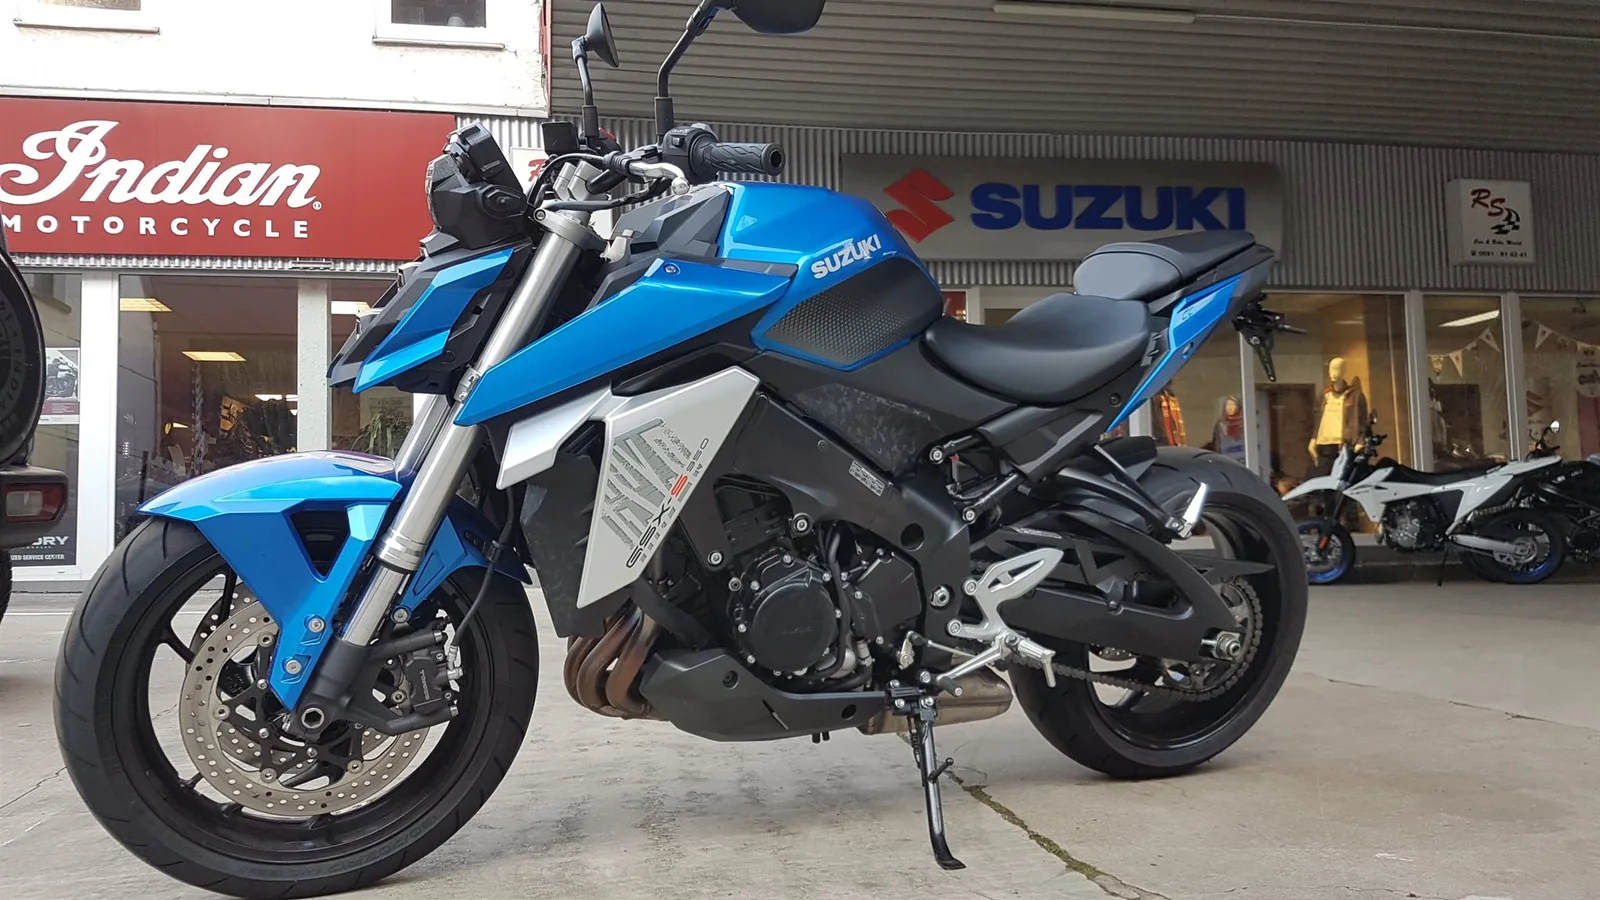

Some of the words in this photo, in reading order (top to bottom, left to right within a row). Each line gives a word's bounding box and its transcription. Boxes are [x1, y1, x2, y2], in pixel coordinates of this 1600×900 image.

[0, 120, 321, 208] Indian
[1, 215, 309, 239] MOTORCYCLE
[970, 182, 1246, 231] SUZUKI
[811, 233, 882, 279] SUZUKI
